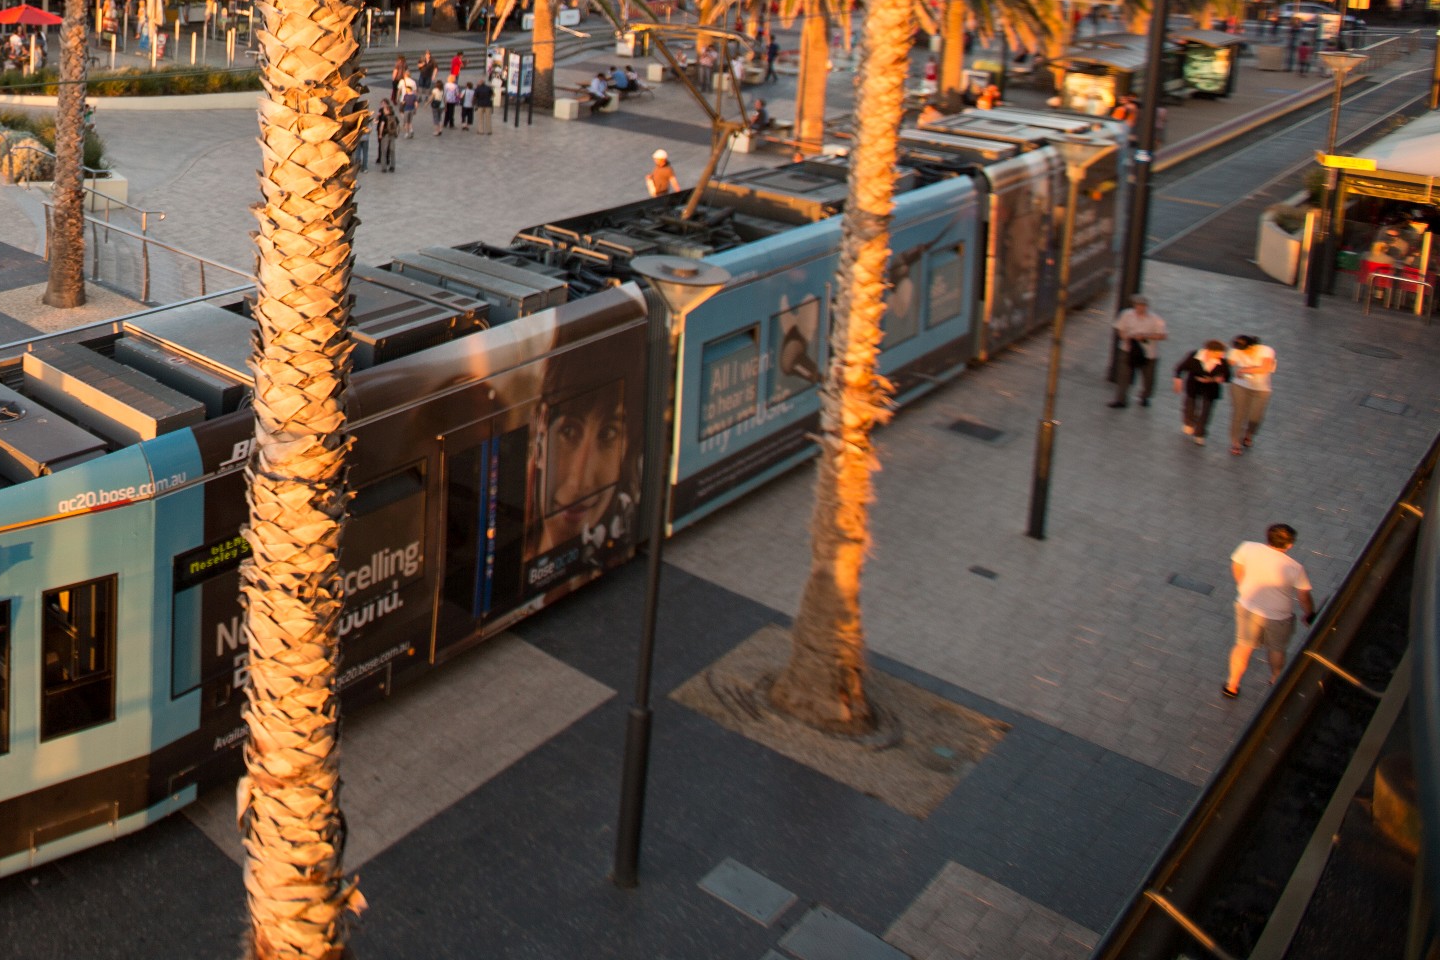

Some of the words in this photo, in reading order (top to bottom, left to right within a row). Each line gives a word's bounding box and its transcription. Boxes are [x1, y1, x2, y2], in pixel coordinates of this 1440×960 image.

[57, 471, 187, 514] qc20.bose.com.au
[189, 548, 238, 575] Moseley
[340, 540, 424, 597] celling.
[527, 561, 555, 585] Bose
[337, 580, 404, 637] ound.
